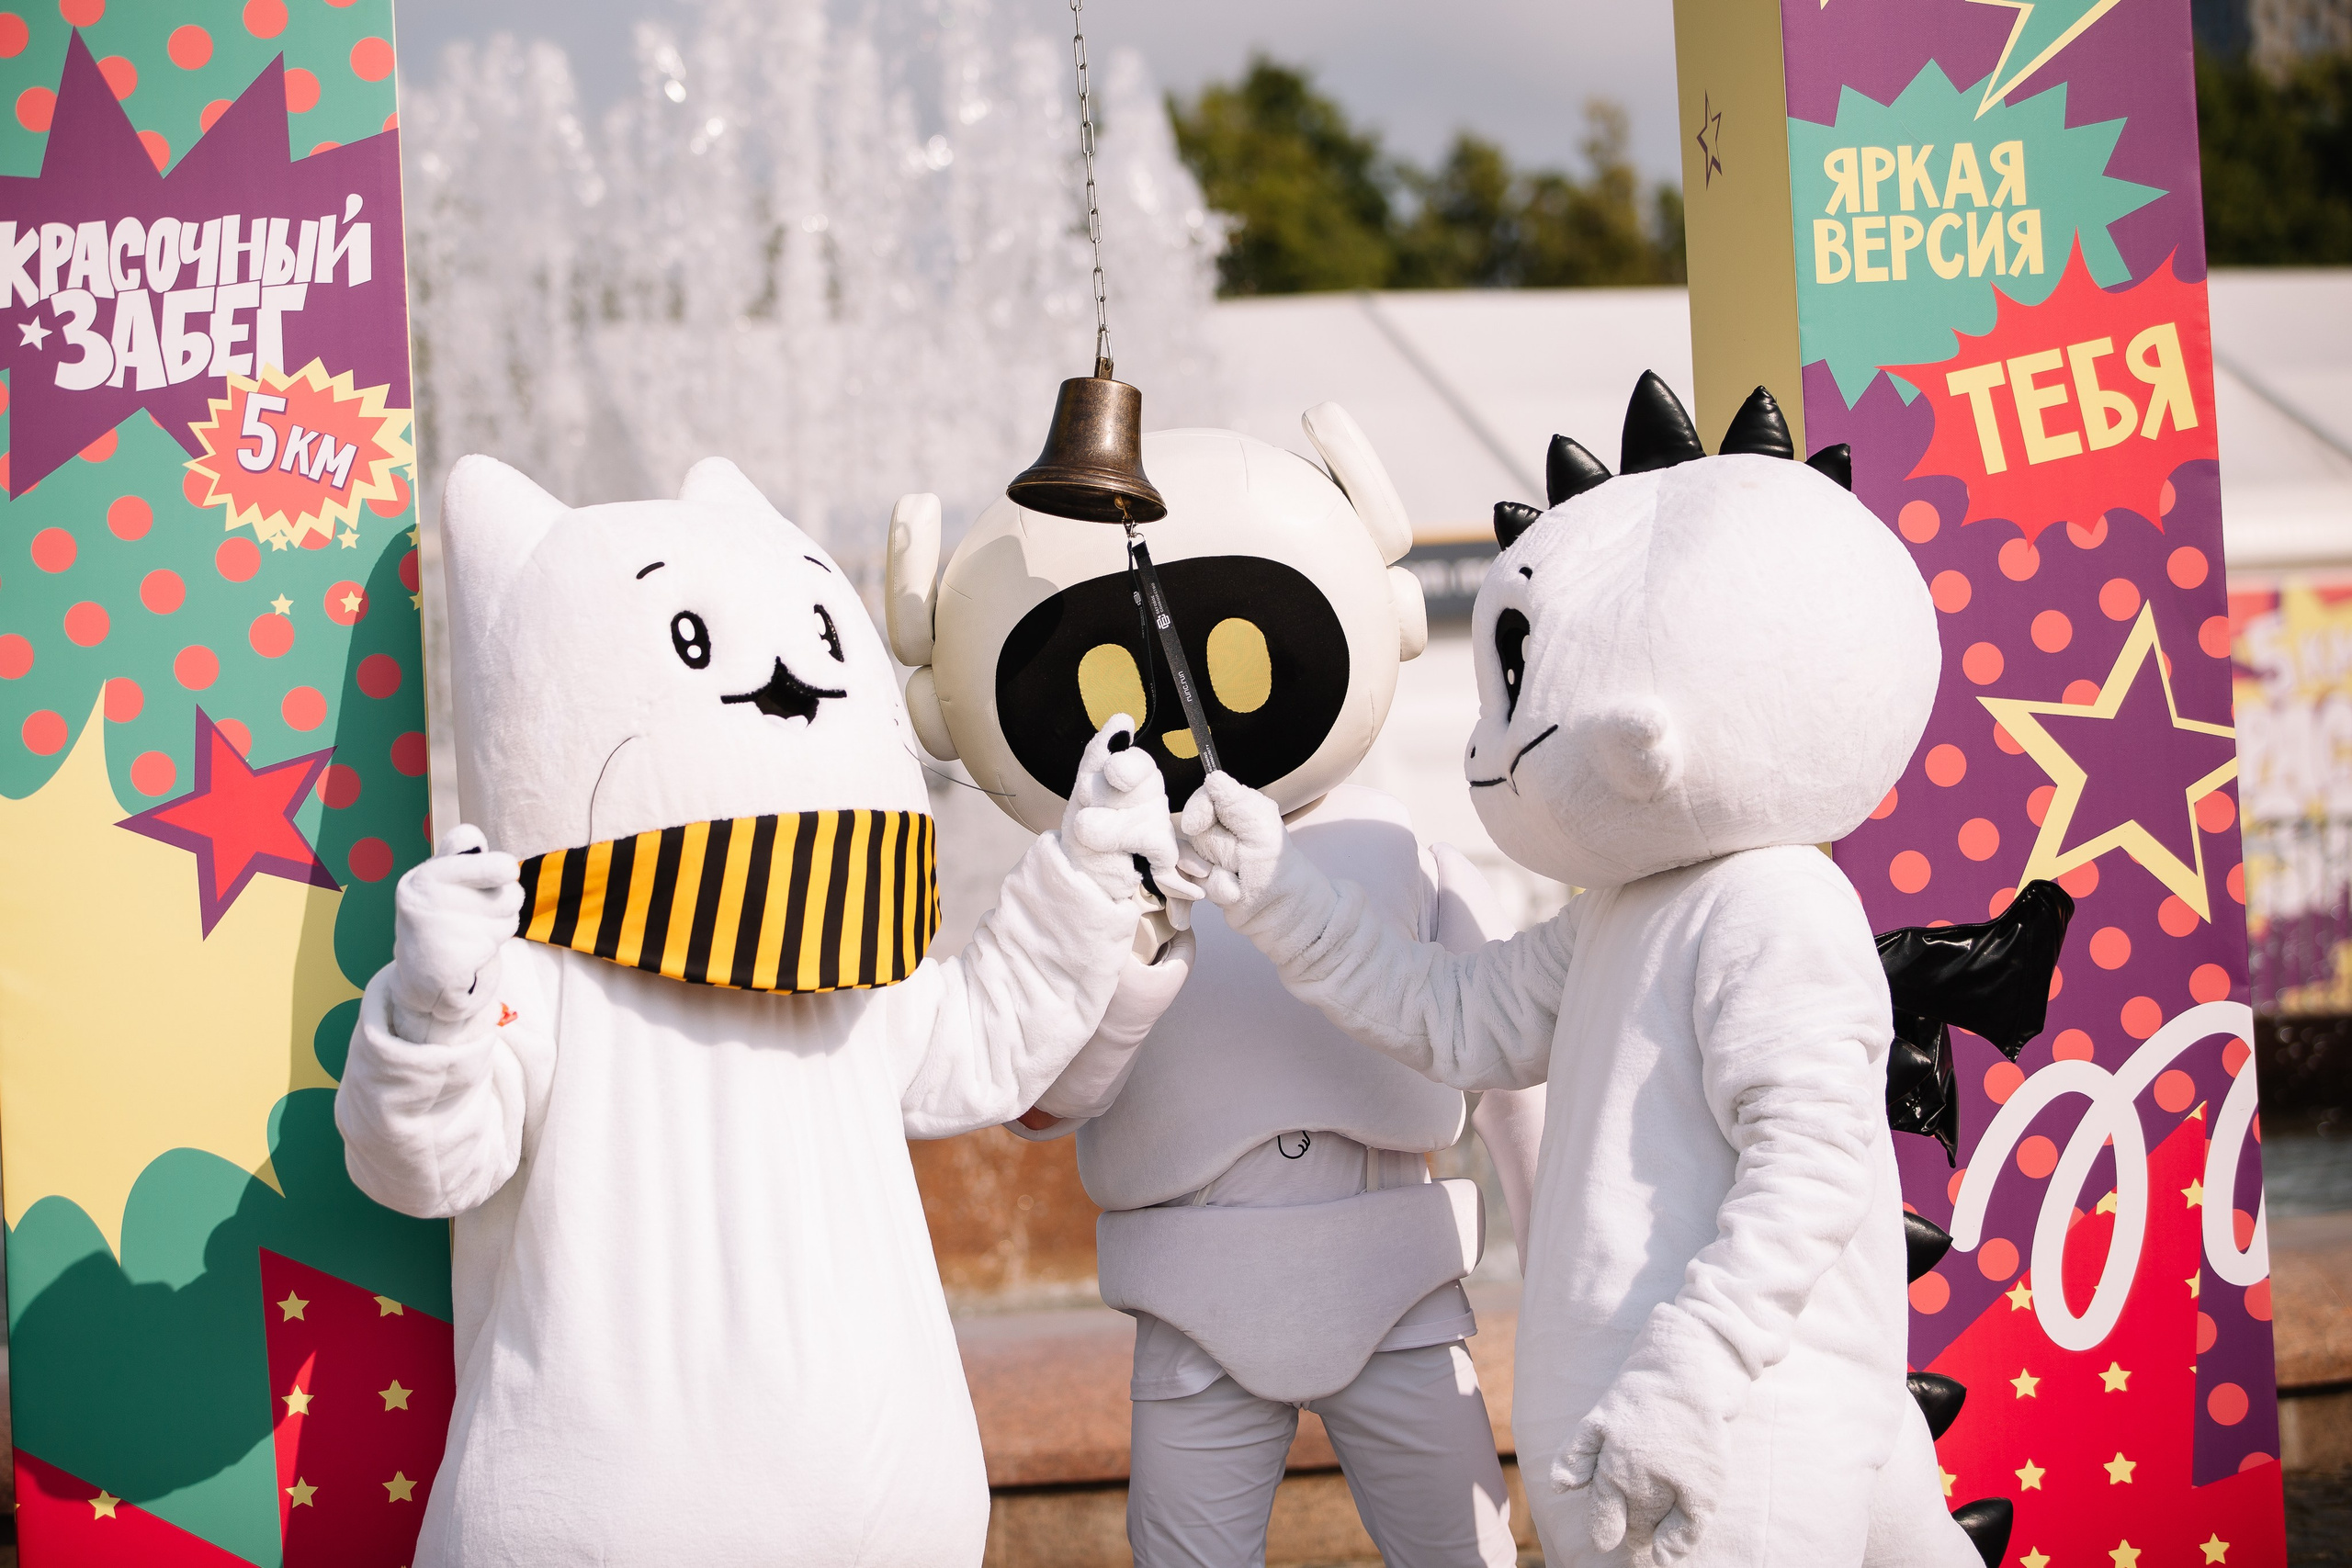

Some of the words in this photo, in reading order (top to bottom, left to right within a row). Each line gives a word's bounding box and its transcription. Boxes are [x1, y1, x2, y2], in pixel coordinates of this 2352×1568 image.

[1823, 141, 2028, 215] ЯРКАЯ
[0, 193, 371, 309] КРАСОЧНЫЙ
[1813, 209, 2044, 284] ВЕРСИЯ
[50, 280, 309, 392] ЗАБЕГ
[237, 391, 287, 473] 5
[1945, 321, 2199, 475] ТЕБЯ
[1178, 671, 1193, 702] runc.run
